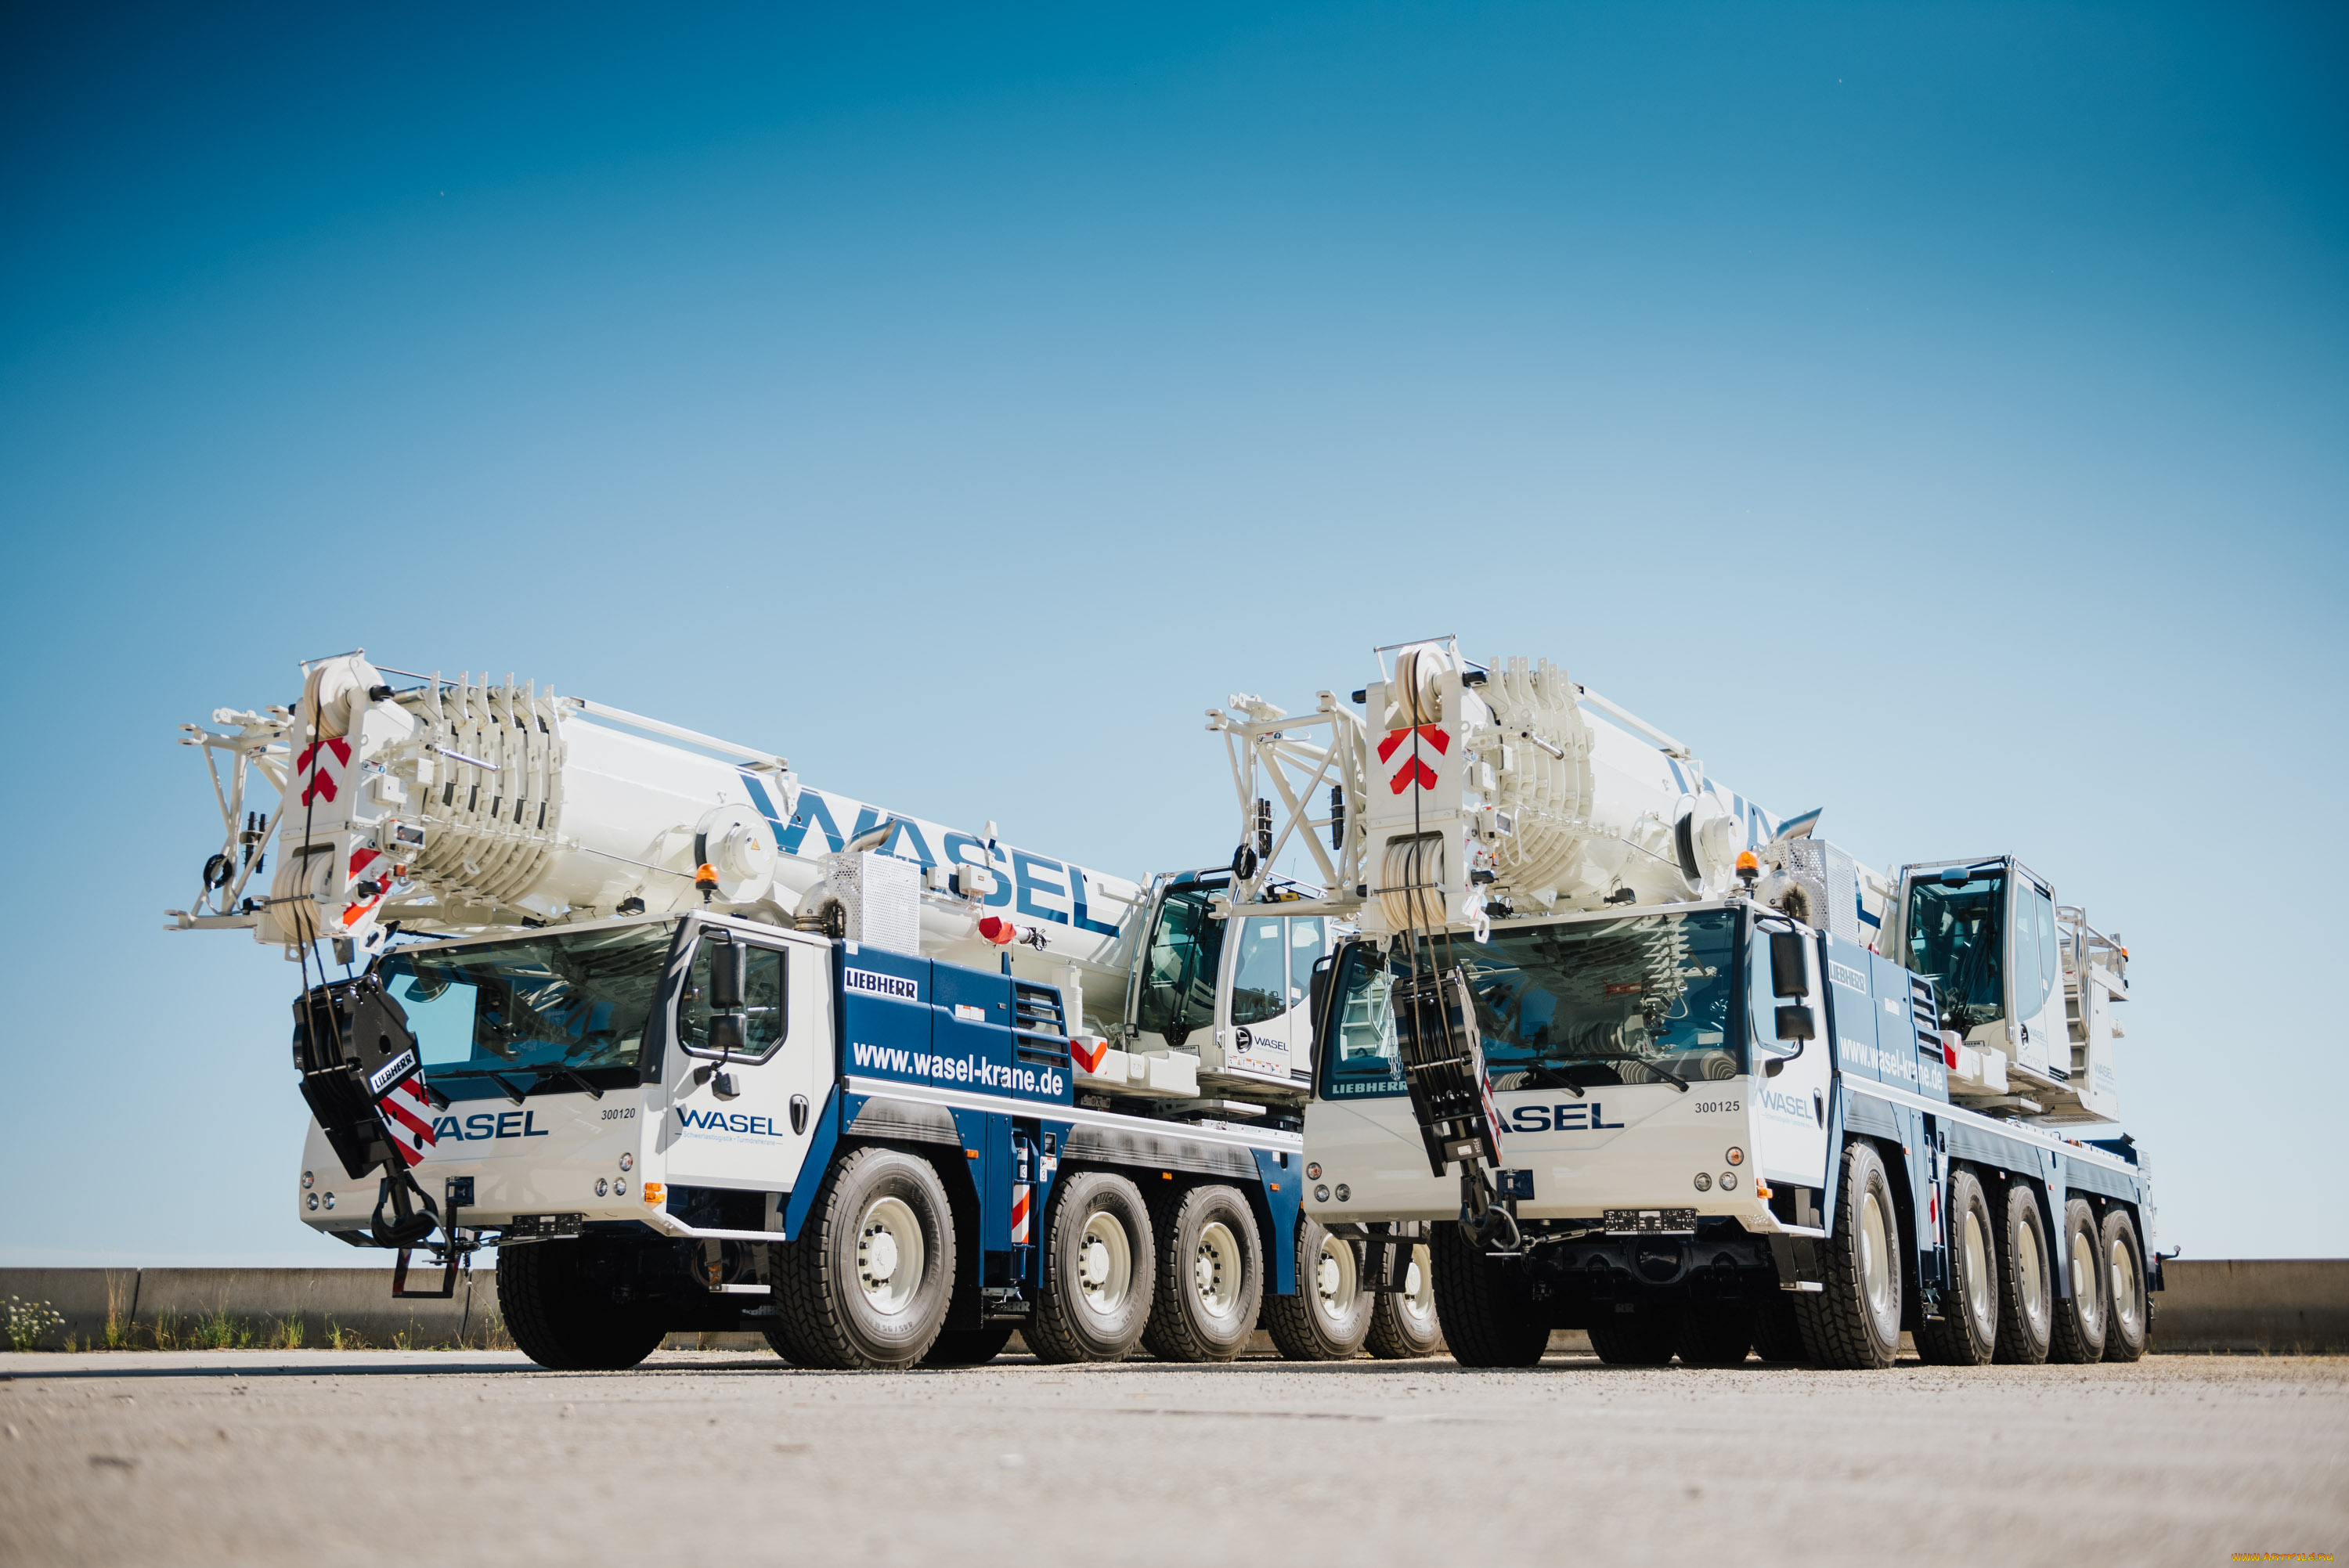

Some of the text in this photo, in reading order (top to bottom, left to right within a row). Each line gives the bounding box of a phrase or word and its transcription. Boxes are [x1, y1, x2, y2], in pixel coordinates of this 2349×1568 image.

[735, 768, 1120, 939] WASEL
[846, 970, 915, 998] LIEBHERR
[1829, 961, 1865, 992] LIEBHERR
[1254, 1036, 1289, 1051] WASEL
[374, 1054, 413, 1089] LIEBHERR
[853, 1042, 1063, 1095] www.wasel-krane.de
[1840, 1036, 1943, 1091] www.wasel-krane.de
[1332, 1081, 1408, 1094] LIEBHERR
[1759, 1087, 1813, 1119] WASEL
[601, 1108, 636, 1120] 300120
[676, 1107, 782, 1137] WASEL
[1695, 1101, 1740, 1113] 300125
[433, 1110, 549, 1142] ASEL
